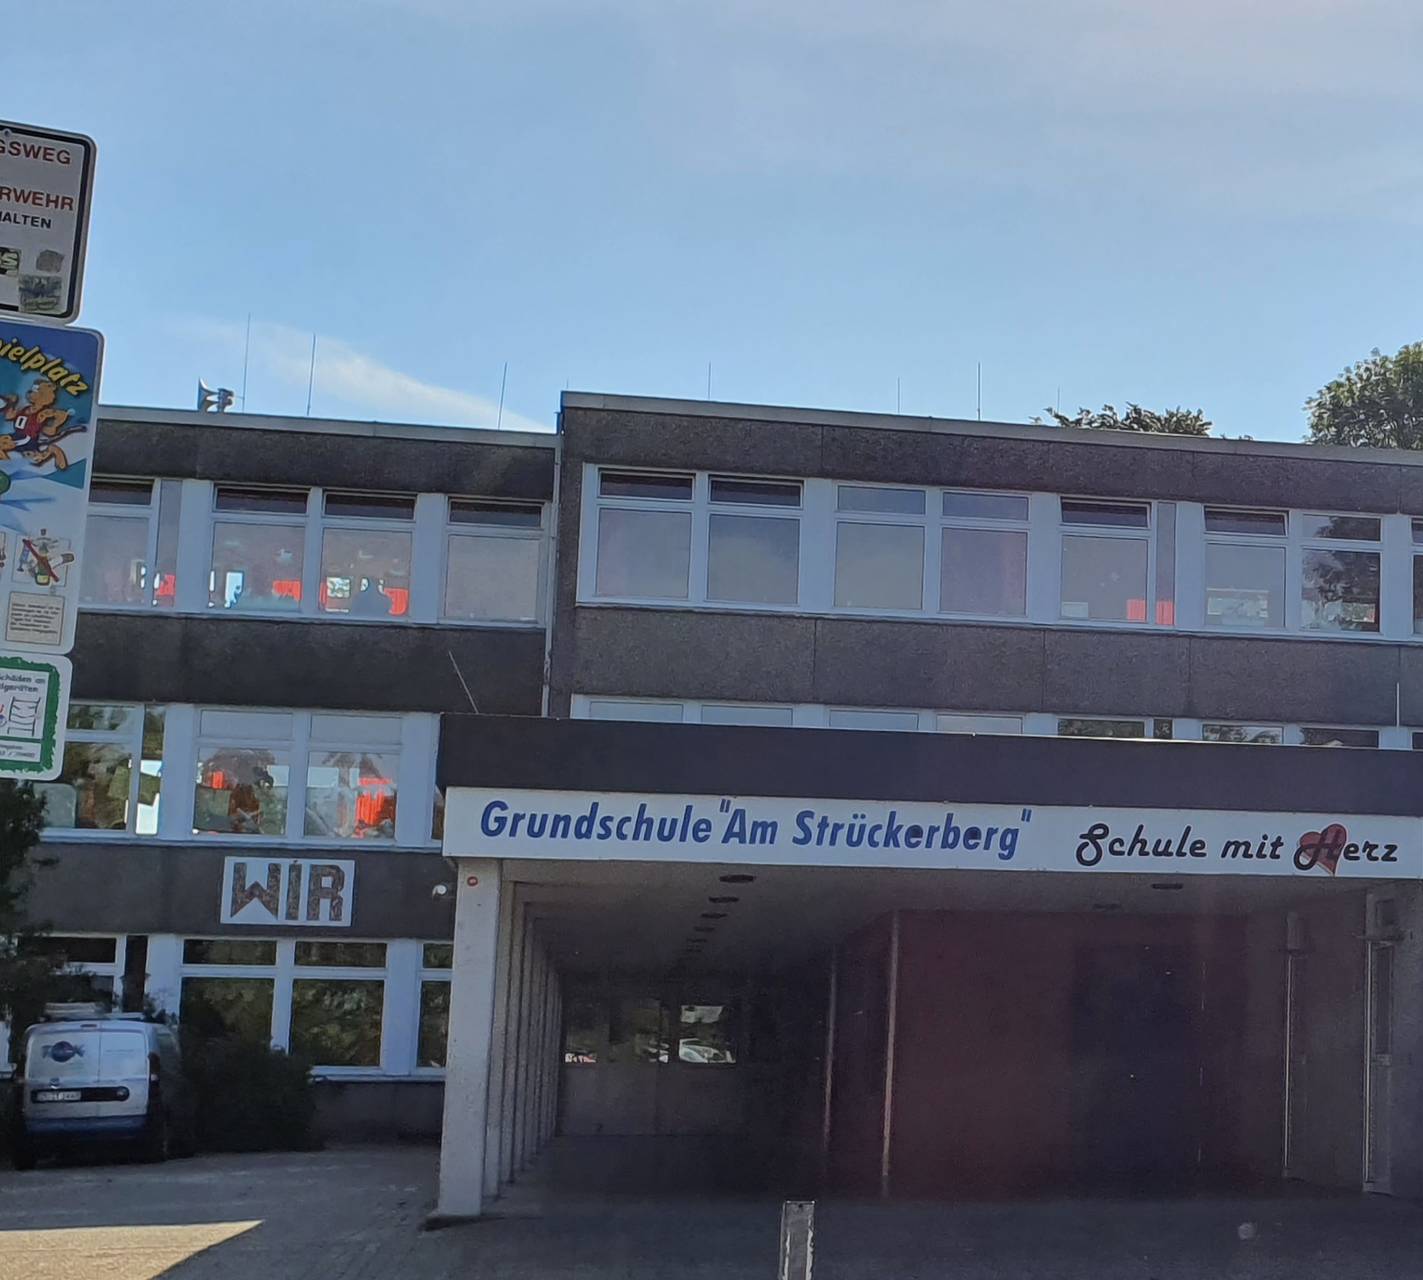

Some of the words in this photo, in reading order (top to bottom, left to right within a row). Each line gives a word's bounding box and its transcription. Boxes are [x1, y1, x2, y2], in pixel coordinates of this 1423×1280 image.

[0, 338, 88, 396] ielplatz
[480, 800, 712, 844] Grundschule
[792, 808, 1032, 861] Strückerberg"
[1075, 823, 1207, 867] Schule
[1220, 834, 1285, 860] mit
[1293, 825, 1399, 871] Herz
[229, 860, 346, 922] WIR
